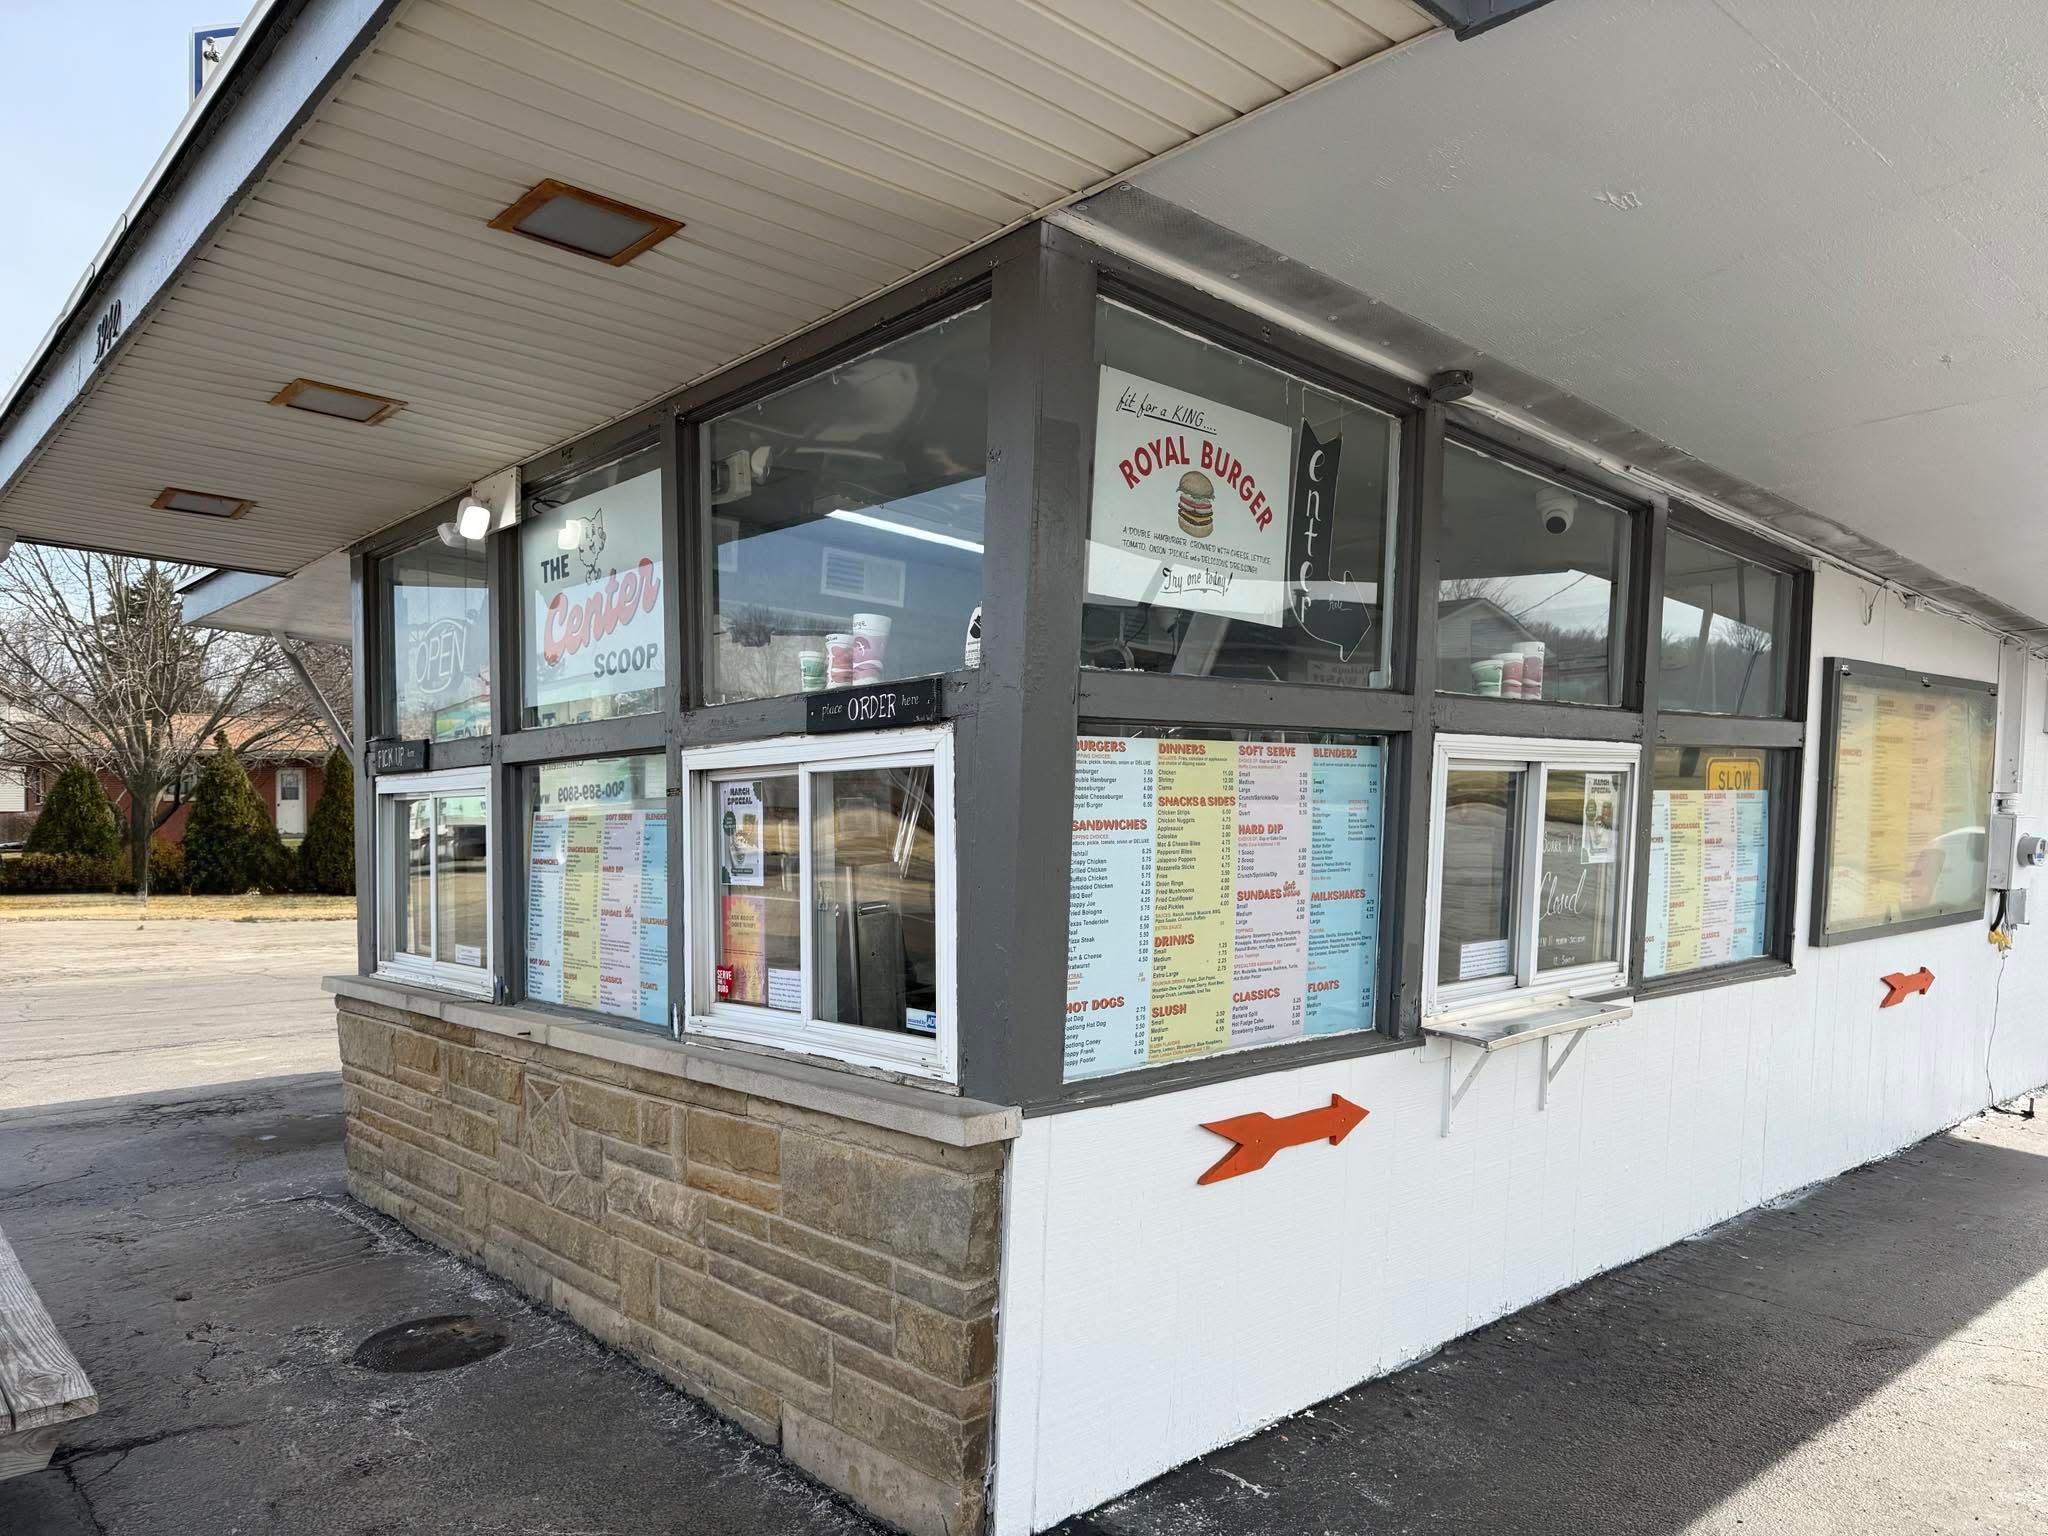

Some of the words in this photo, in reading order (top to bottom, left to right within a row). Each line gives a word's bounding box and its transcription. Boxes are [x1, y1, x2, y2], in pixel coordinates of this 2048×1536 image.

[1116, 386, 1136, 412] fit
[1137, 393, 1158, 418] for
[1160, 408, 1167, 417] a
[1118, 435, 1190, 490] ROYAL
[1201, 440, 1273, 533] BURGER
[1128, 527, 1151, 539] DOUBLE
[1153, 533, 1188, 547] HAMBURGER
[1190, 540, 1216, 553] CROWNED
[1201, 555, 1228, 568] DELICIOUS
[541, 553, 570, 584] THE
[1162, 567, 1182, 595] Try
[1187, 572, 1202, 586] one
[1205, 567, 1233, 596] today!
[543, 557, 661, 667] Center
[415, 626, 467, 682] OPEN
[593, 643, 658, 679] SCOOP
[848, 693, 896, 721] ORDER
[901, 694, 919, 706] here
[1158, 743, 1206, 755] DINNERS
[1239, 745, 1264, 756] SOFT
[1267, 746, 1297, 757] SERVE
[1313, 748, 1357, 758] BLENDERZ
[395, 746, 404, 767] UP
[1718, 770, 1752, 790] SLOW
[730, 787, 750, 796] MARCH
[727, 797, 753, 805] SPECIAL
[1158, 796, 1199, 807] SNACKS
[1200, 797, 1206, 806] &
[1207, 796, 1236, 807] SIDES
[1072, 819, 1148, 831] SANDWICHES
[1239, 824, 1265, 835] HARD
[1268, 824, 1284, 834] DIP
[1237, 889, 1282, 902] SUNDAES
[1311, 889, 1366, 902] MILKSHAKES
[1154, 934, 1195, 948] DRINKS
[717, 970, 732, 980] SERVE
[717, 985, 729, 993] BURG
[1308, 980, 1340, 993] FLOATS
[1233, 988, 1280, 1003] CLASSICS
[1065, 1001, 1089, 1014] HOT
[1091, 996, 1125, 1011] DOGS
[1152, 1003, 1187, 1018] SLUSH
[1096, 1021, 1107, 1029] Dog
[1065, 1041, 1084, 1049] ootlong
